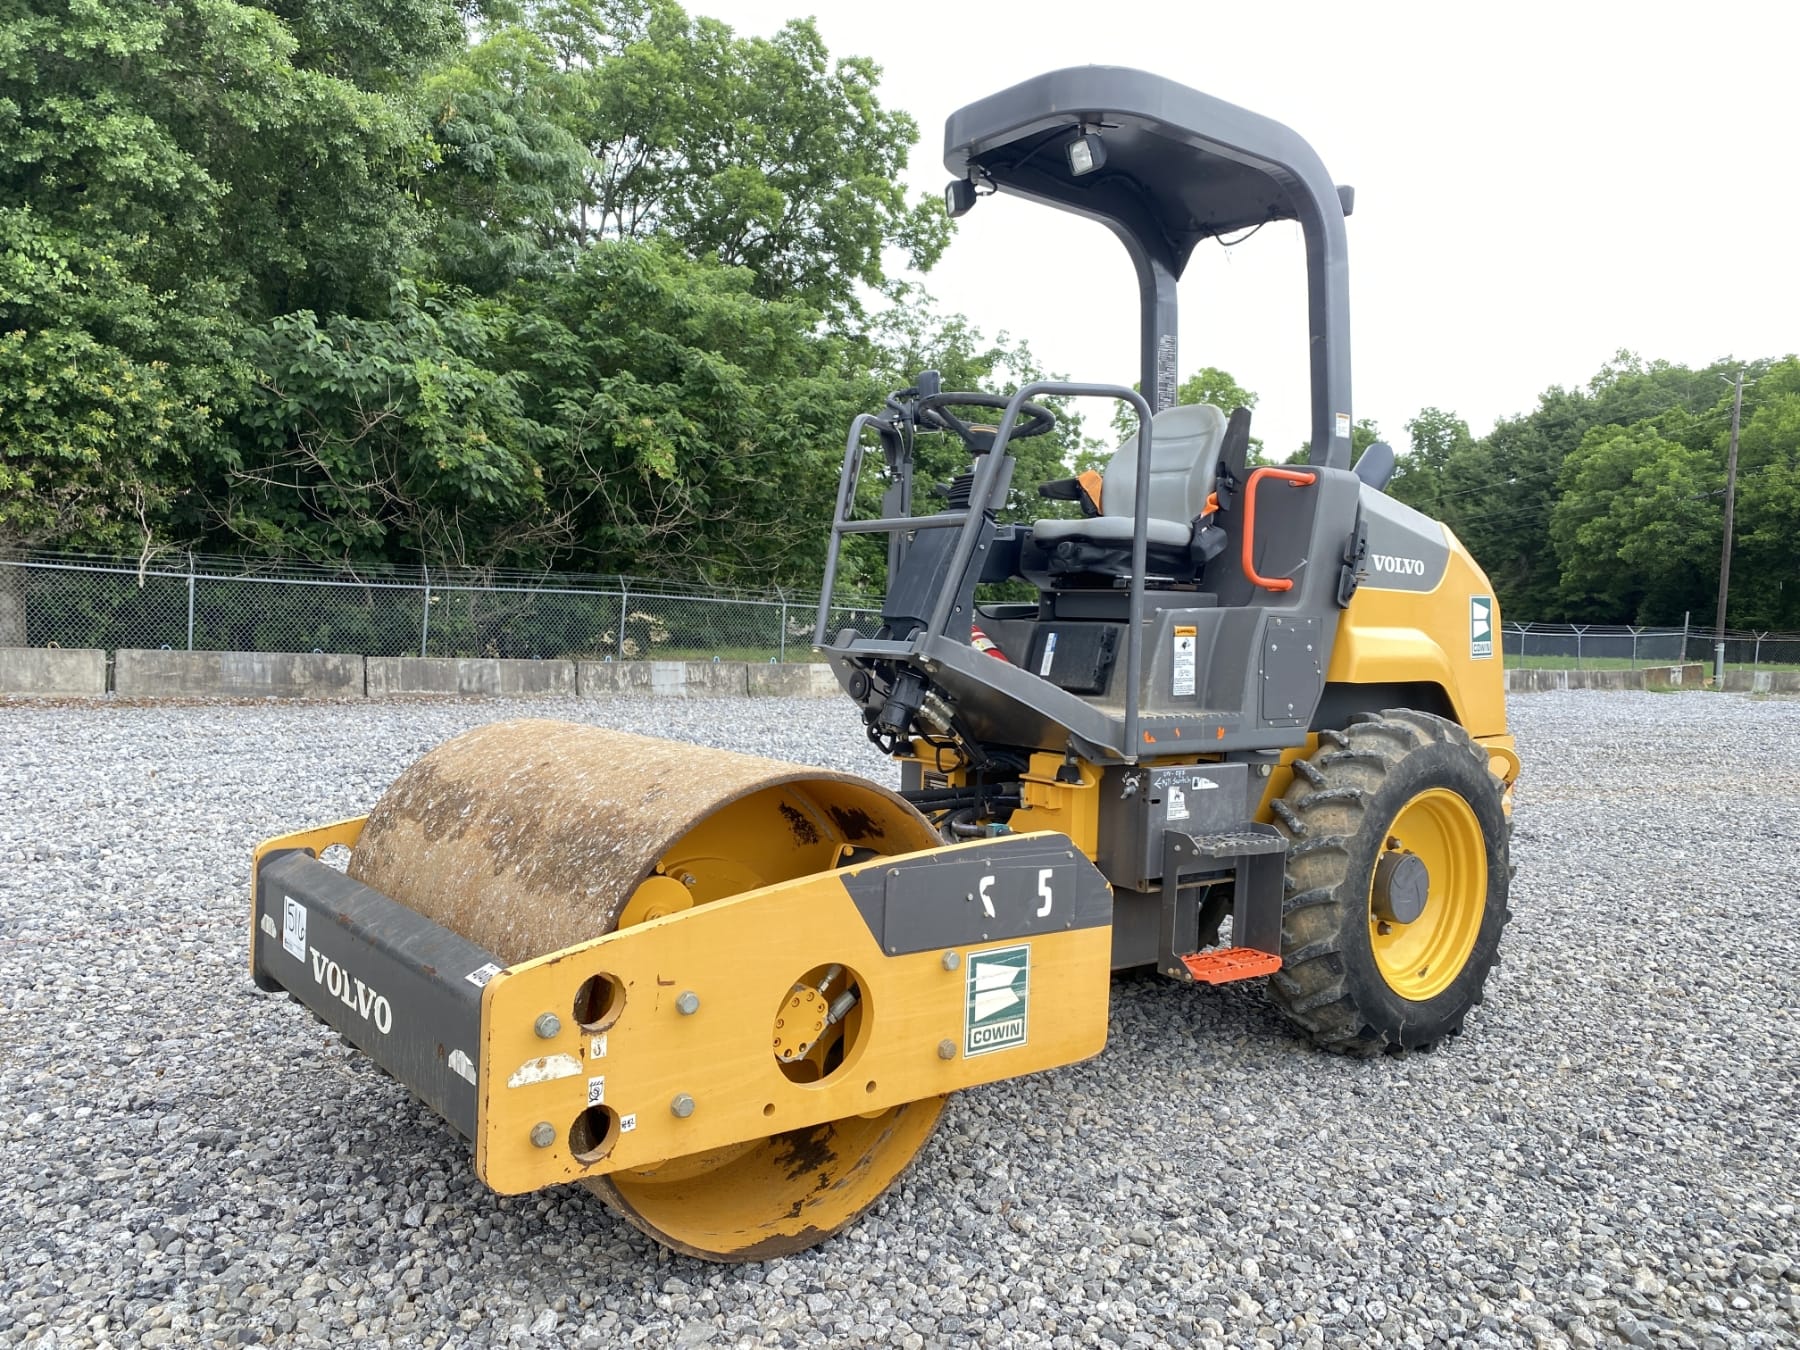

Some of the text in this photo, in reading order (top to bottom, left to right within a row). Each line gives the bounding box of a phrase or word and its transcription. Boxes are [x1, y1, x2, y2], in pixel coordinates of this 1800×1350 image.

[1371, 554, 1425, 576] VOLVO
[1036, 868, 1053, 917] 5
[309, 945, 392, 1034] VOLVO
[972, 1021, 1020, 1045] COWIN
